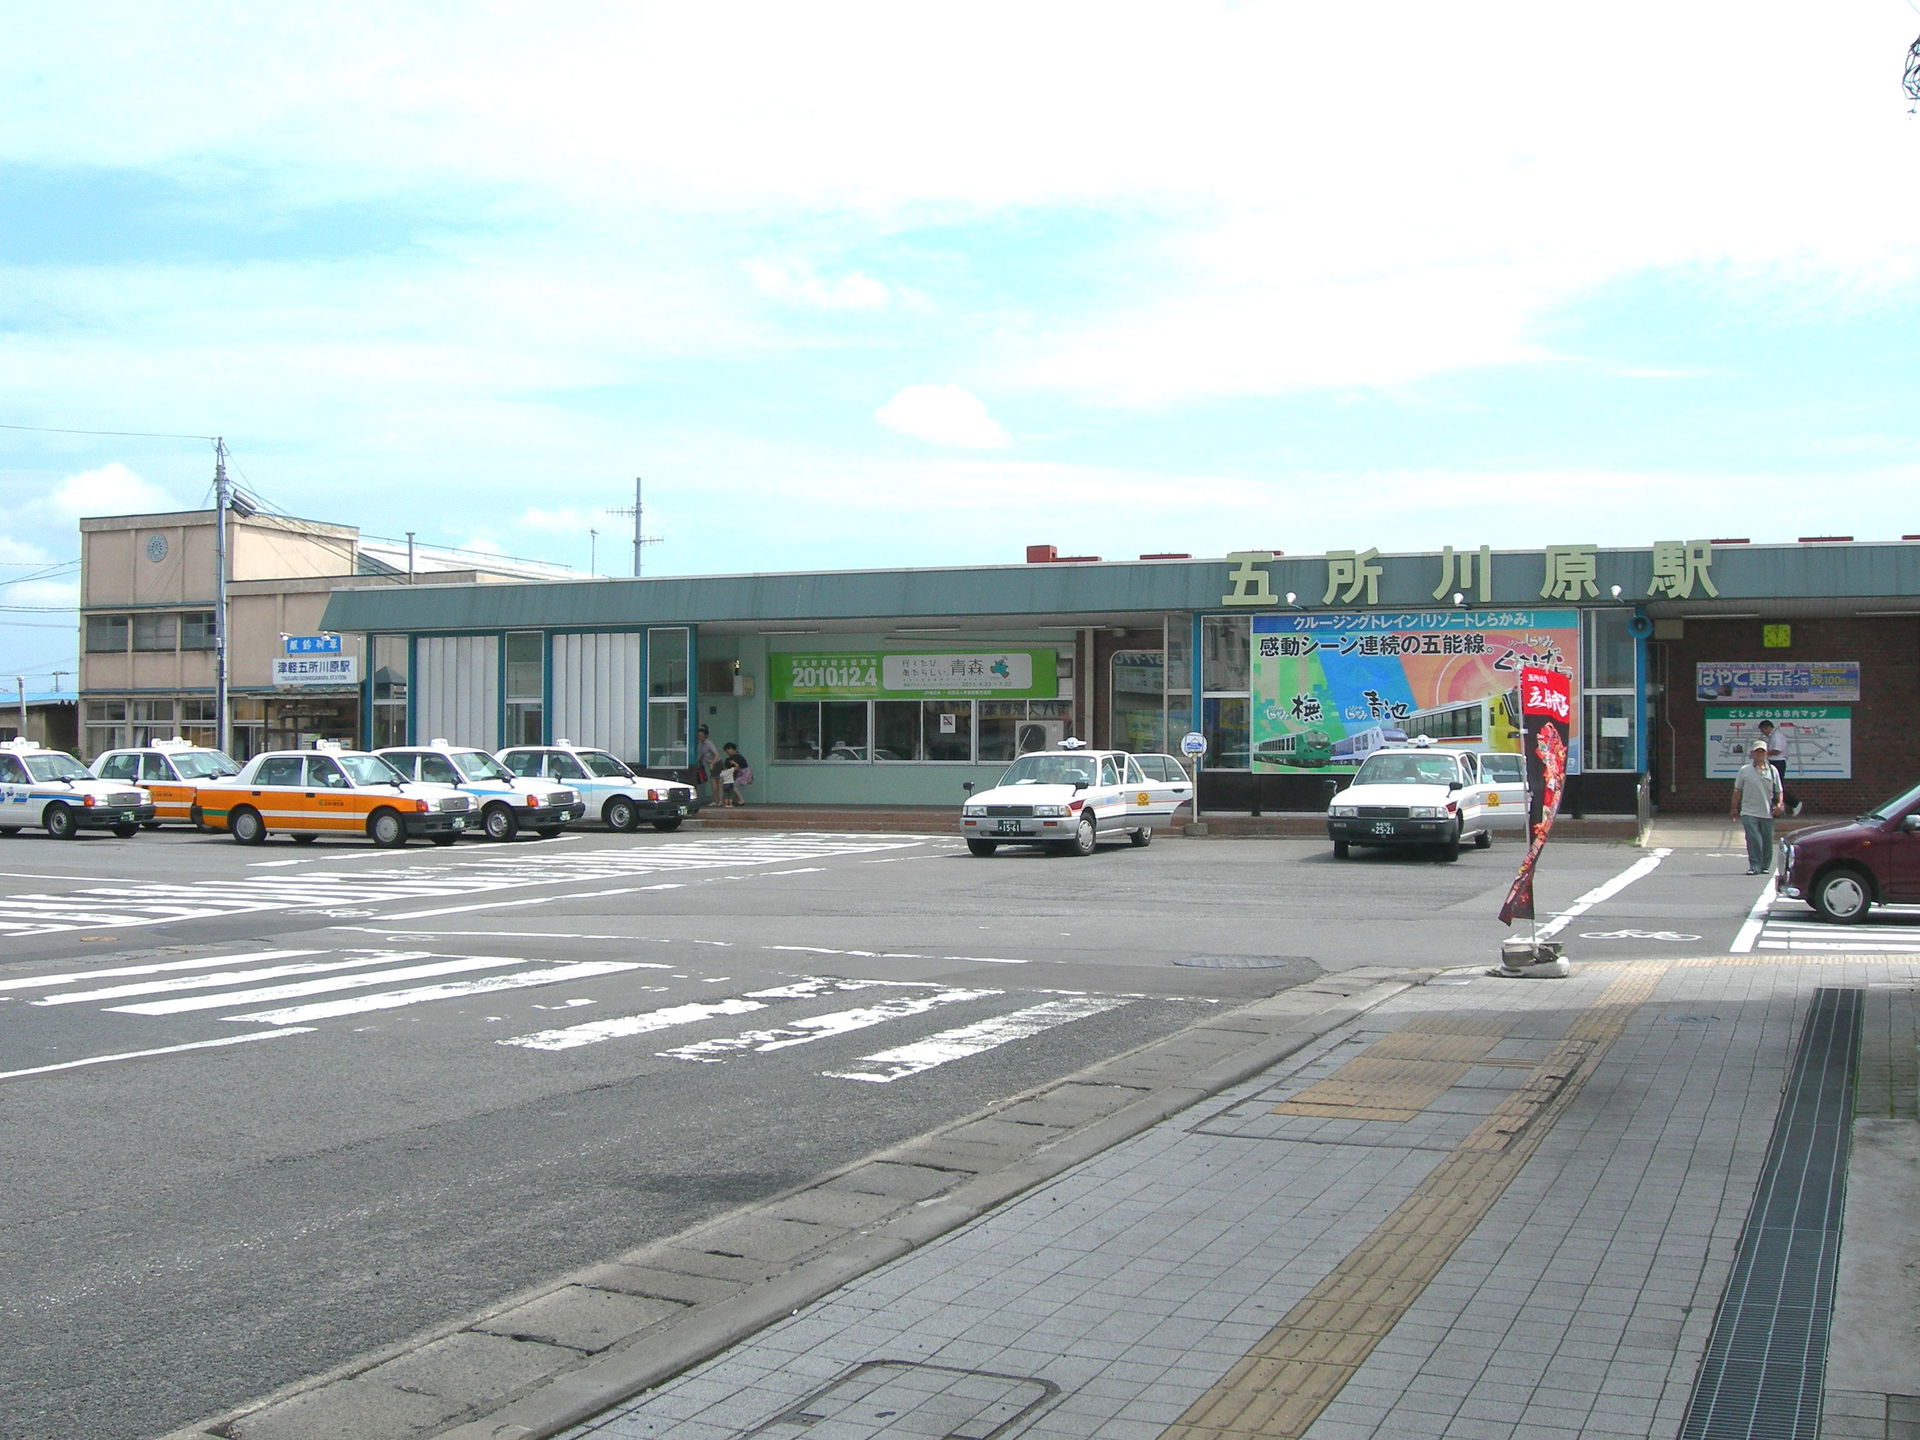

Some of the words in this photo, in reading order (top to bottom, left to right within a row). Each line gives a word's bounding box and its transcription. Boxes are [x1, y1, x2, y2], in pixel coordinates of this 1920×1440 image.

[1221, 539, 1719, 606] 五所川原駅
[1293, 612, 1535, 630] クルージングトレイン「リゾートしらかみ」
[1259, 633, 1495, 657] 感動シーン連続の五能線。
[277, 660, 351, 674] 津軽五所川原駅
[950, 658, 984, 676] 青森
[792, 667, 877, 687] 2010.12.4
[1698, 669, 1783, 687] はやて東京
[1363, 689, 1411, 721] 青池
[1728, 709, 1828, 718] ごしょがわら市内マップ
[1003, 824, 1019, 832] 15-61
[1375, 826, 1394, 835] 25-21
